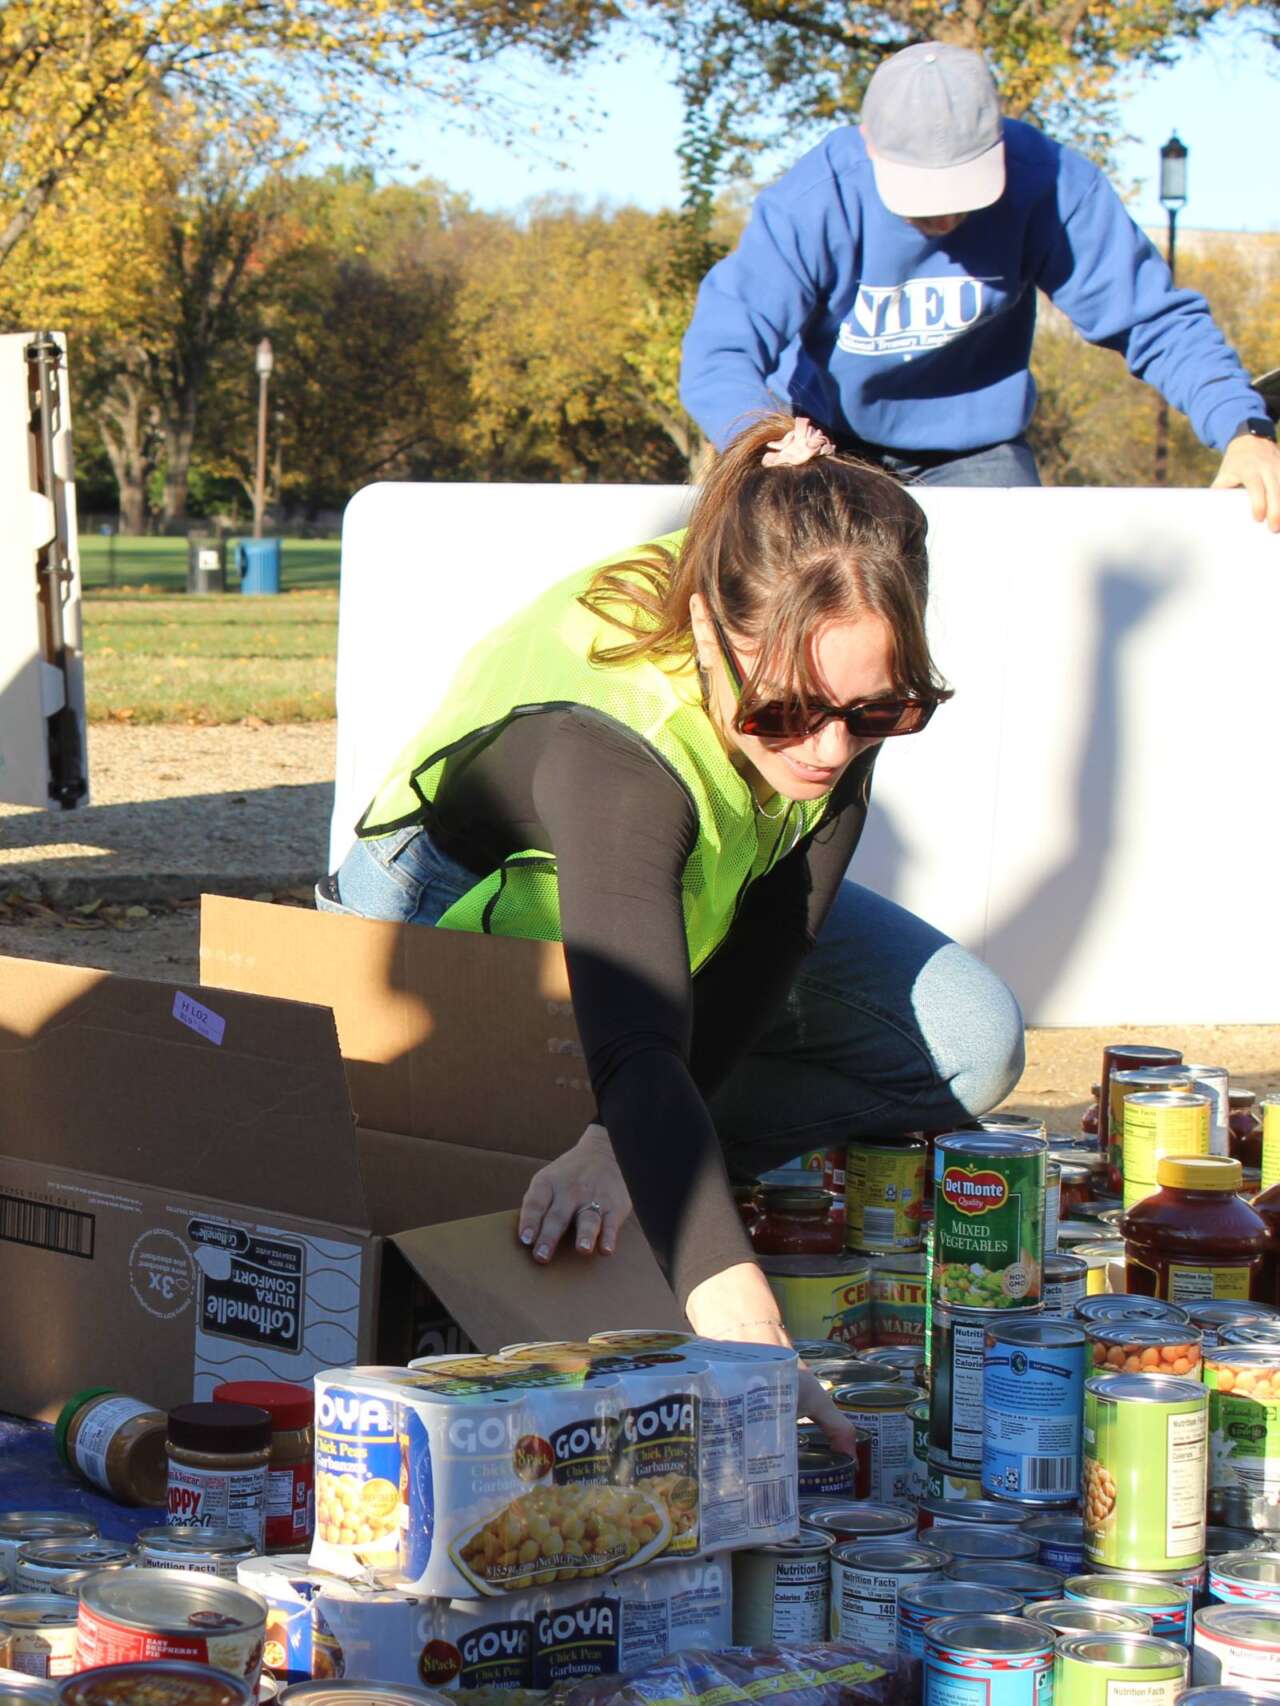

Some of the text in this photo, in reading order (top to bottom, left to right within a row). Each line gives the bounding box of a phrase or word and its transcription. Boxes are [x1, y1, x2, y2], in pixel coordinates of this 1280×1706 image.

[945, 1178, 1004, 1197] Del Monte
[958, 1196, 984, 1208] Quality
[951, 1220, 990, 1237] MIXED
[940, 1230, 1008, 1252] VEGETABLES
[233, 1270, 296, 1294] COMFORT
[255, 1288, 296, 1310] ULTRA
[206, 1294, 296, 1339] Cottonelle
[955, 1327, 983, 1338] Nutriti
[317, 1394, 386, 1432] OYA
[624, 1402, 694, 1443] GOYA
[145, 1559, 217, 1573] Nutrition Facts
[776, 1562, 816, 1576] Nutrition
[843, 1571, 897, 1588] Nutrition Facts
[774, 1593, 801, 1601] Calories
[879, 1604, 895, 1615] 140
[539, 1606, 615, 1645] GOYA
[1113, 1686, 1146, 1697] Nutrition
